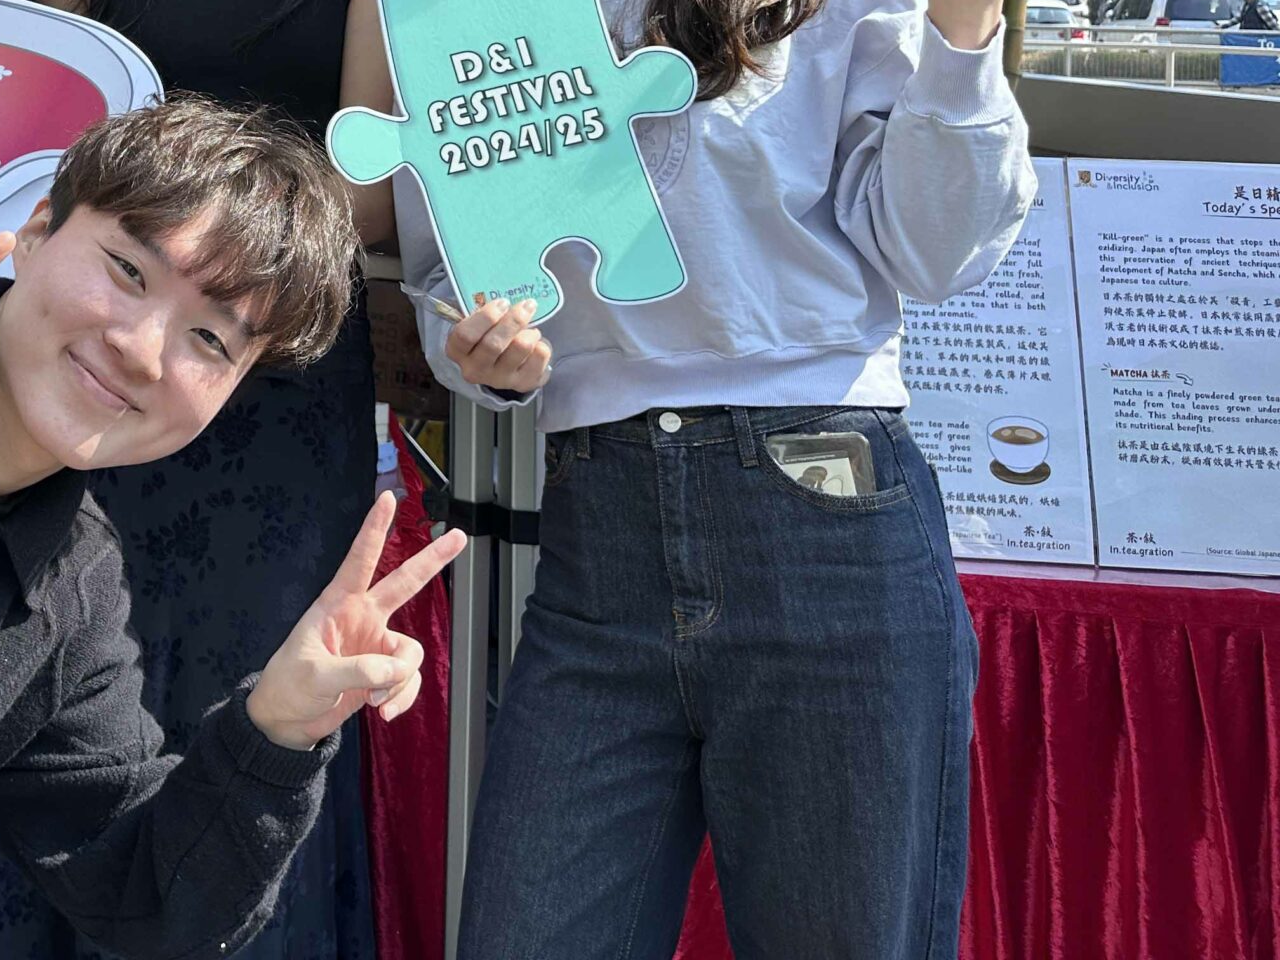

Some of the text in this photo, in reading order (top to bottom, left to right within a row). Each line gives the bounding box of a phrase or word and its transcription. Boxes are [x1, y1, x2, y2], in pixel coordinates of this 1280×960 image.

[427, 66, 594, 133] FESTIVAL
[439, 107, 606, 175] 2024/25
[1095, 172, 1140, 184] Diversity
[1179, 237, 1210, 246] process
[1216, 237, 1234, 245] that
[1240, 238, 1263, 247] stops
[1098, 244, 1137, 254] oxidizing.
[1141, 245, 1166, 254] Japan
[1169, 246, 1192, 256] often
[1195, 248, 1229, 257] employs
[1234, 248, 1247, 256] the
[1027, 260, 1043, 270] full
[1099, 254, 1115, 263] this
[1123, 255, 1175, 265] preservation
[1183, 257, 1193, 266] of
[1201, 258, 1230, 266] ancient
[1018, 270, 1043, 280] fresh,
[1100, 265, 1151, 275] development
[1155, 266, 1165, 276] of
[1167, 267, 1197, 276] Matcha
[1217, 269, 1250, 279] Sencha,
[1252, 270, 1275, 279] which
[987, 281, 1010, 290] green
[1101, 276, 1192, 287] Japanese tea culture.
[1030, 292, 1045, 300] and
[971, 300, 985, 308] tea
[991, 301, 1008, 309] that
[1014, 302, 1022, 310] is
[1026, 303, 1046, 311] both
[921, 309, 936, 317] and
[938, 310, 978, 319] aromatic.
[1110, 368, 1148, 379] MATCHA
[1113, 388, 1143, 397] Matcha
[1146, 389, 1154, 397] is
[1167, 389, 1191, 400] finely
[1195, 391, 1235, 401] powdered
[1238, 395, 1262, 403] green
[1266, 394, 1280, 402] tea
[1114, 399, 1136, 407] made
[1143, 400, 1164, 409] from
[1171, 401, 1185, 409] tea
[1192, 401, 1220, 411] leaves
[1226, 404, 1251, 413] grown
[1114, 410, 1143, 418] shade.
[1148, 411, 1167, 419] This
[1171, 412, 1203, 423] shading
[1208, 414, 1240, 424] process
[928, 420, 943, 428] tea
[947, 421, 970, 429] made
[1130, 422, 1175, 431] nutritional
[1177, 423, 1214, 434] benefits.
[933, 431, 943, 441] of
[947, 433, 970, 442] green
[949, 443, 971, 453] gives
[1006, 539, 1071, 551] In.tea.gration
[1109, 545, 1174, 557] In.tea.gration
